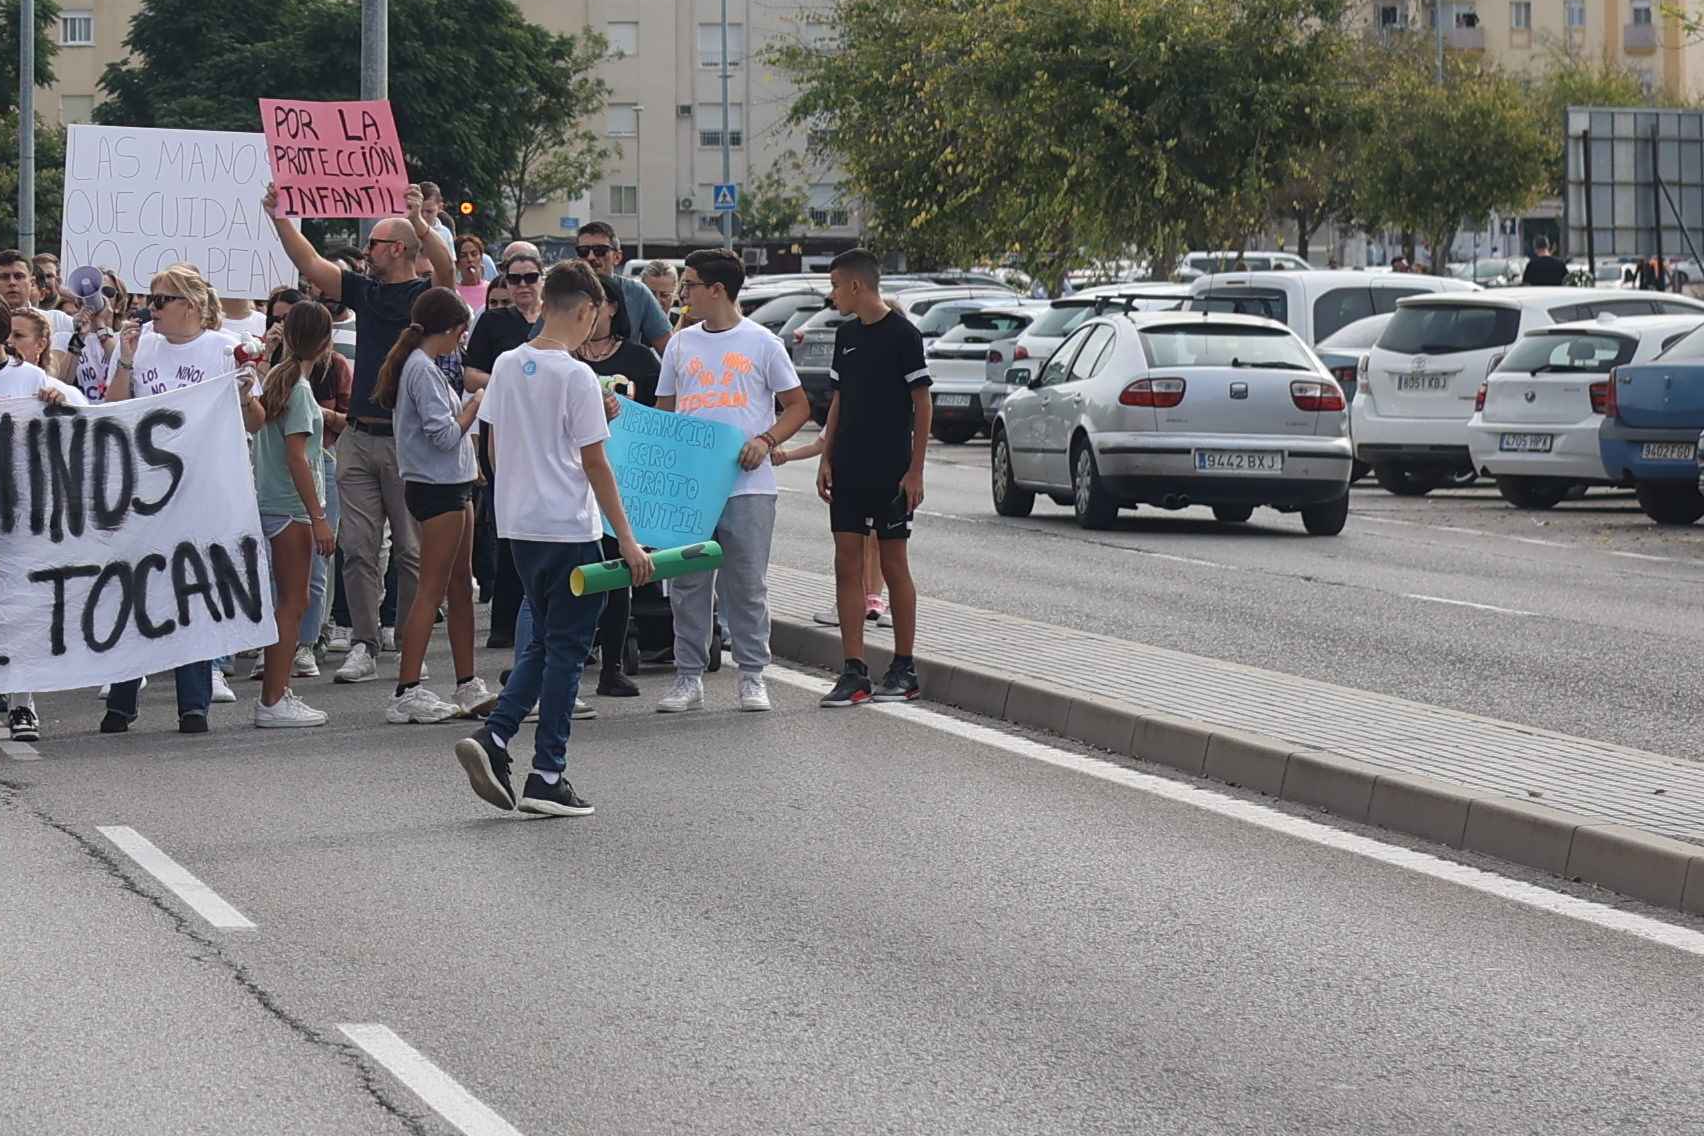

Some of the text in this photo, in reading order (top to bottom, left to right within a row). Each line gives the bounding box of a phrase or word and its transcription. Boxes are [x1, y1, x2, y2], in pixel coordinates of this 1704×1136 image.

[274, 105, 381, 141] POR LA
[71, 127, 142, 181] LAS
[132, 243, 297, 294] GOPEAN
[82, 366, 97, 382] NO
[141, 364, 205, 385] LOS NIÑOS
[1207, 451, 1276, 470] 9442 BXJ
[618, 464, 700, 500] LTRATO
[27, 535, 264, 657] TOCAN
